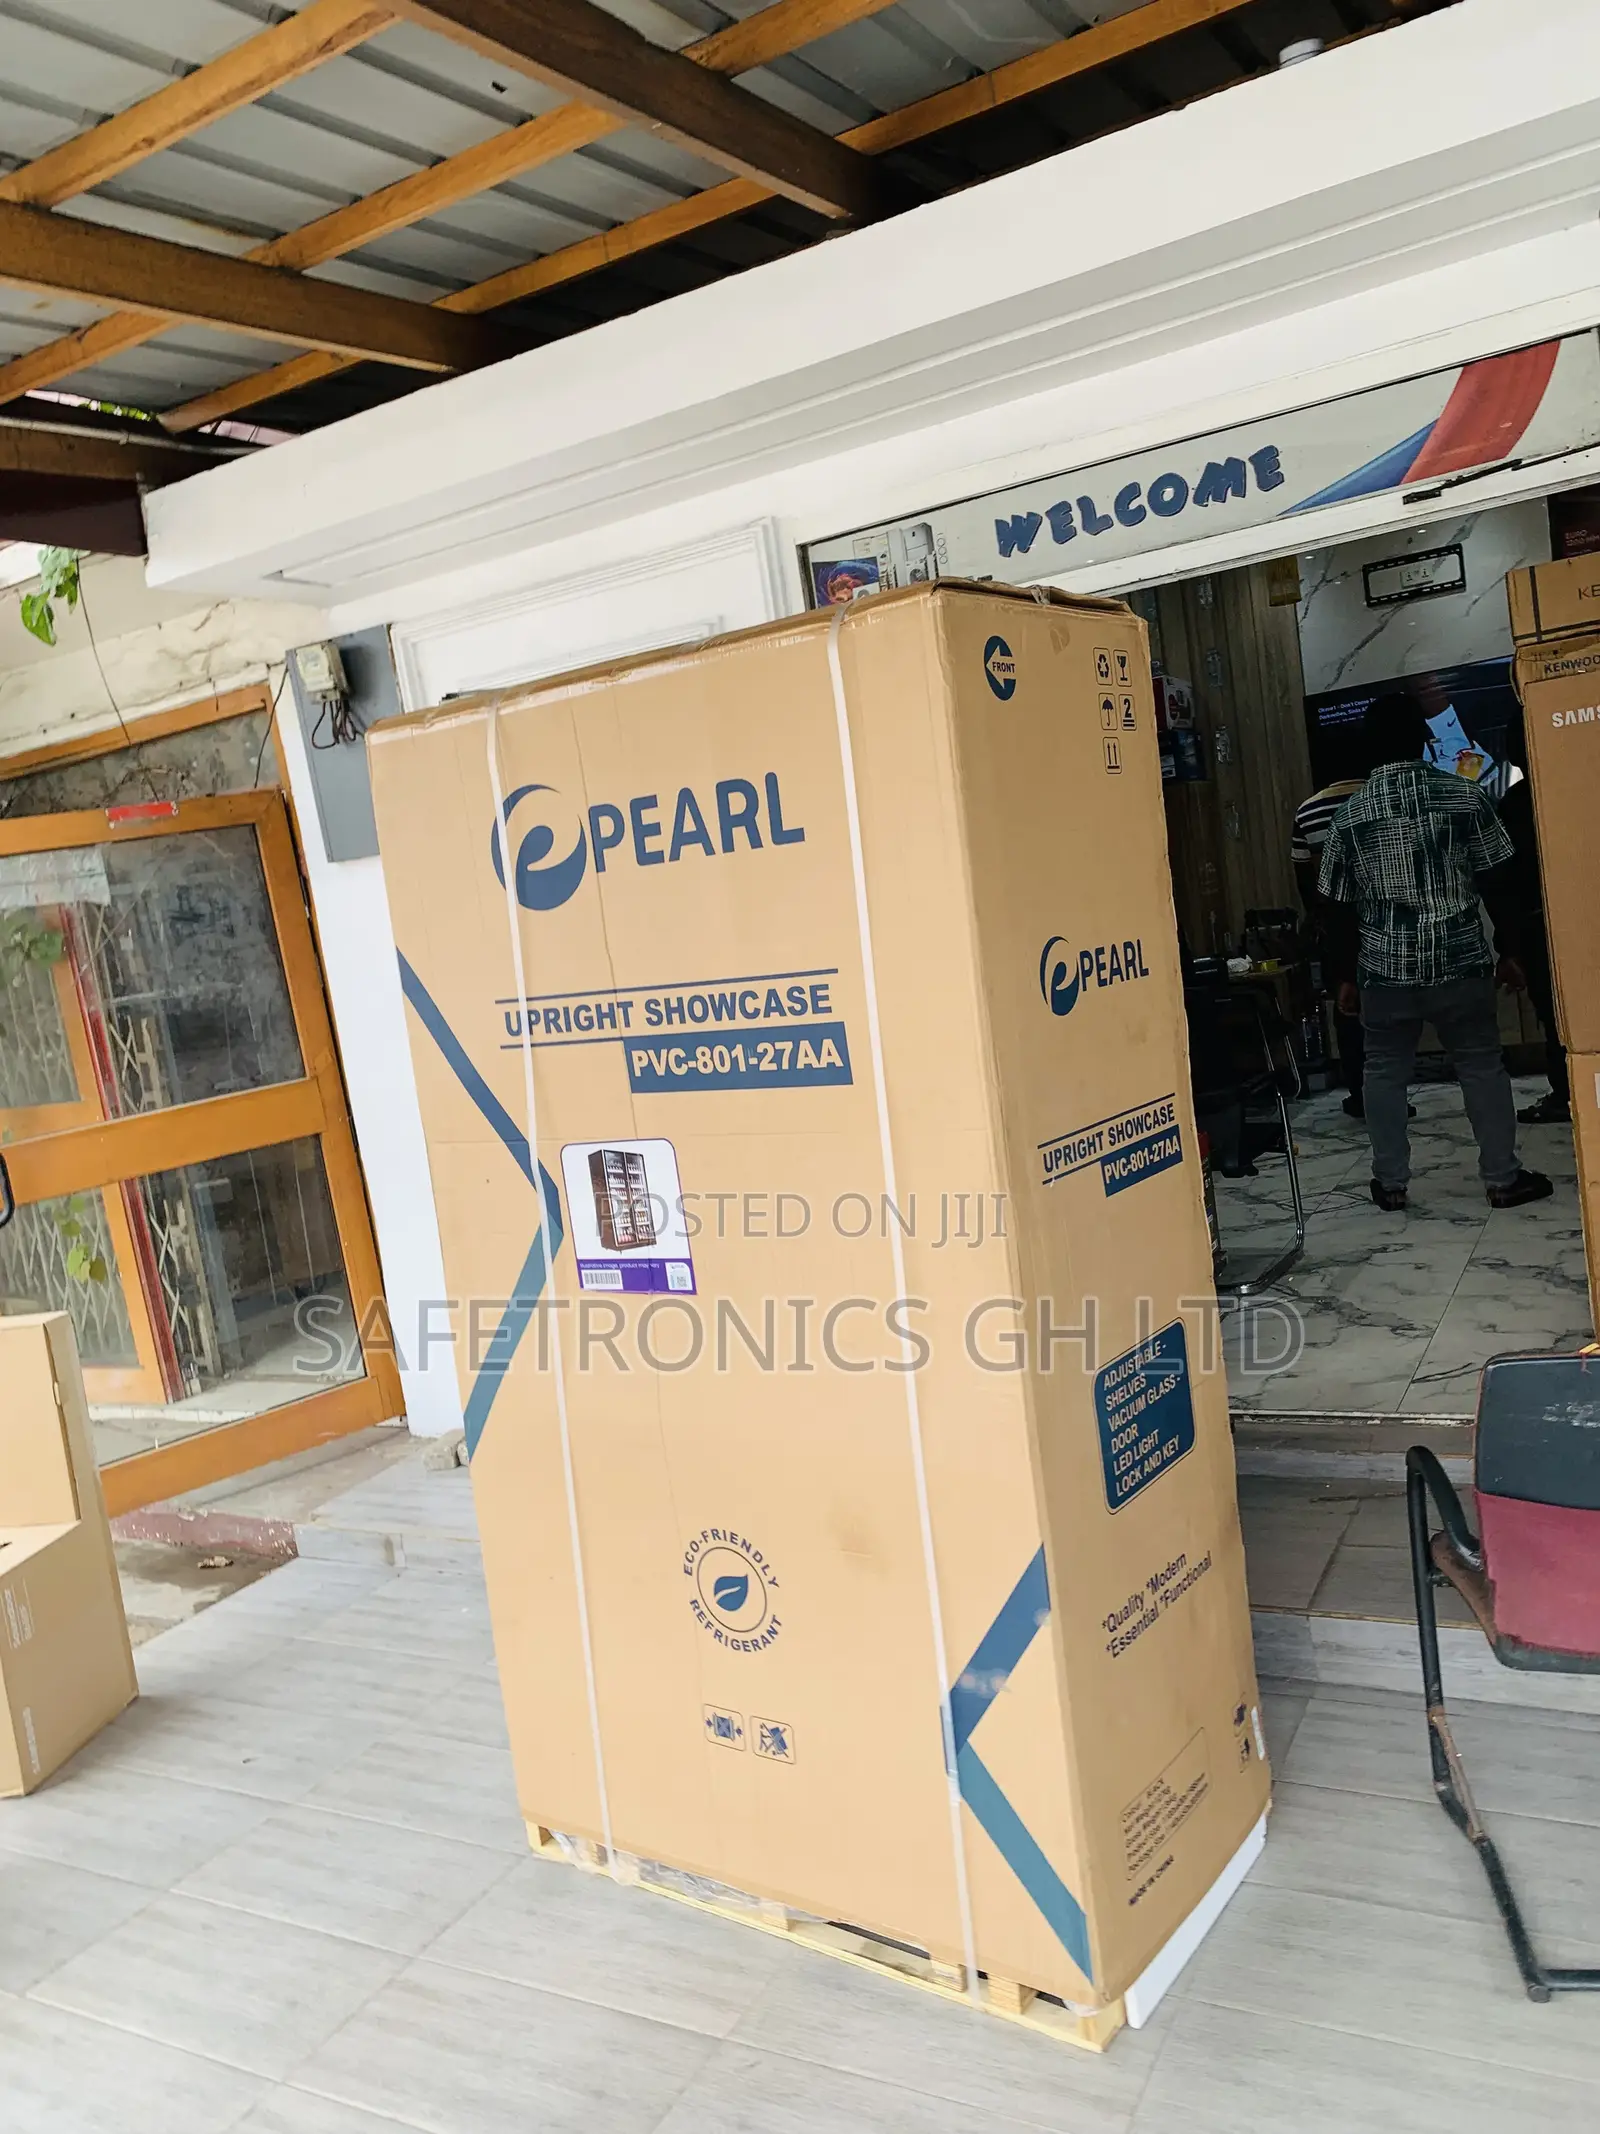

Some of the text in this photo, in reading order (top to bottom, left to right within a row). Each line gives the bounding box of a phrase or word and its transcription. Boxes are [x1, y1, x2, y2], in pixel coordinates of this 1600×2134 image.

[995, 445, 1285, 558] WELCOME
[992, 661, 1016, 674] FRONT
[1123, 697, 1132, 718] 2
[588, 772, 806, 873] PEARL
[1079, 938, 1149, 992] PEARL
[504, 983, 833, 1036] UPRIGHT SHOWCASE
[630, 1038, 845, 1078] PVC-801-27AA
[1043, 1102, 1175, 1173] UPRIGHT SHOWCASE
[1103, 1135, 1181, 1184] PVC-801-27AA
[1105, 1372, 1147, 1412] SHELVES
[1107, 1394, 1147, 1432] VACUUM
[1111, 1423, 1139, 1455] DOOR
[1113, 1429, 1160, 1476] LED LIGHT
[1116, 1435, 1180, 1498] LOCK AND KEY
[683, 1527, 780, 1589] ECO-FRIENDLY
[689, 1598, 783, 1653] REFRIGERANT
